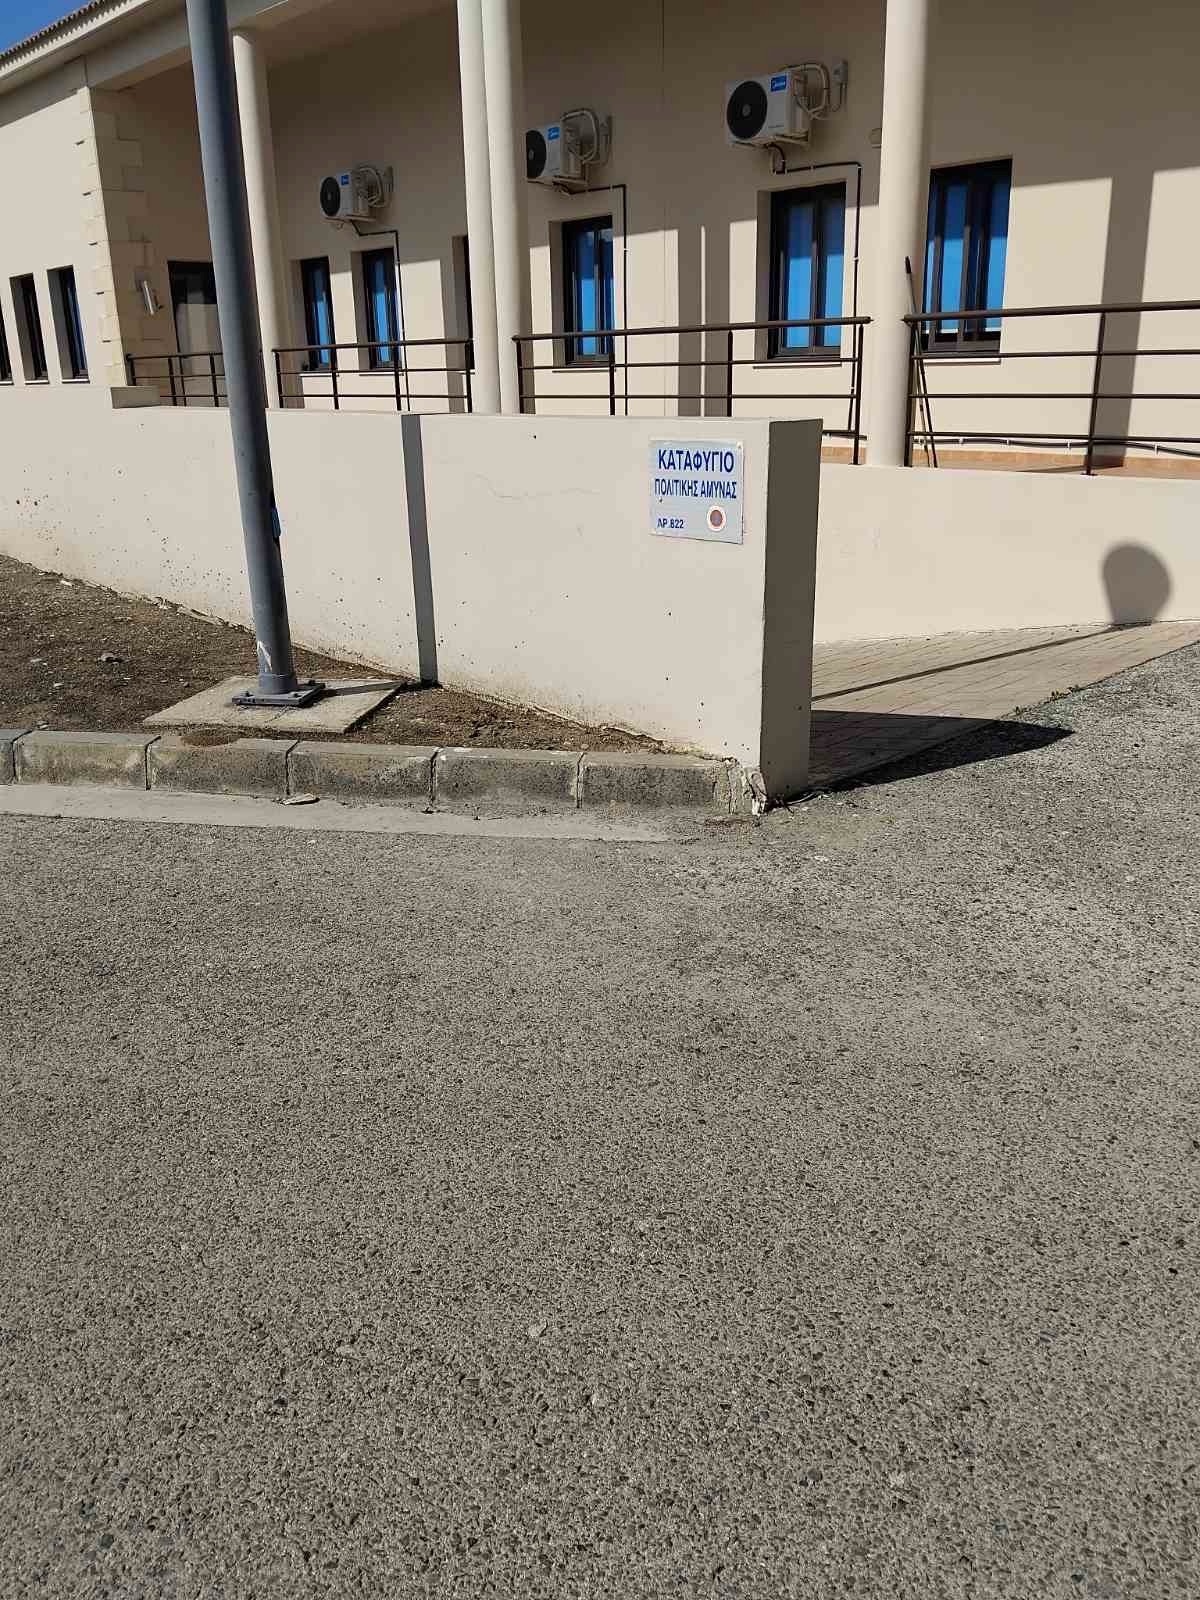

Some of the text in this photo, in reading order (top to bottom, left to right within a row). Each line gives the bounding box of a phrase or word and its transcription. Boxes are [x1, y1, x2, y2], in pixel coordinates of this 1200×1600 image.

[658, 449, 734, 472] ΚΑΤΑΦΥΓΙΟ
[655, 478, 737, 499] ΠΟΛΙΤΙΚΗΣ ΑΜΥΝΑΣ
